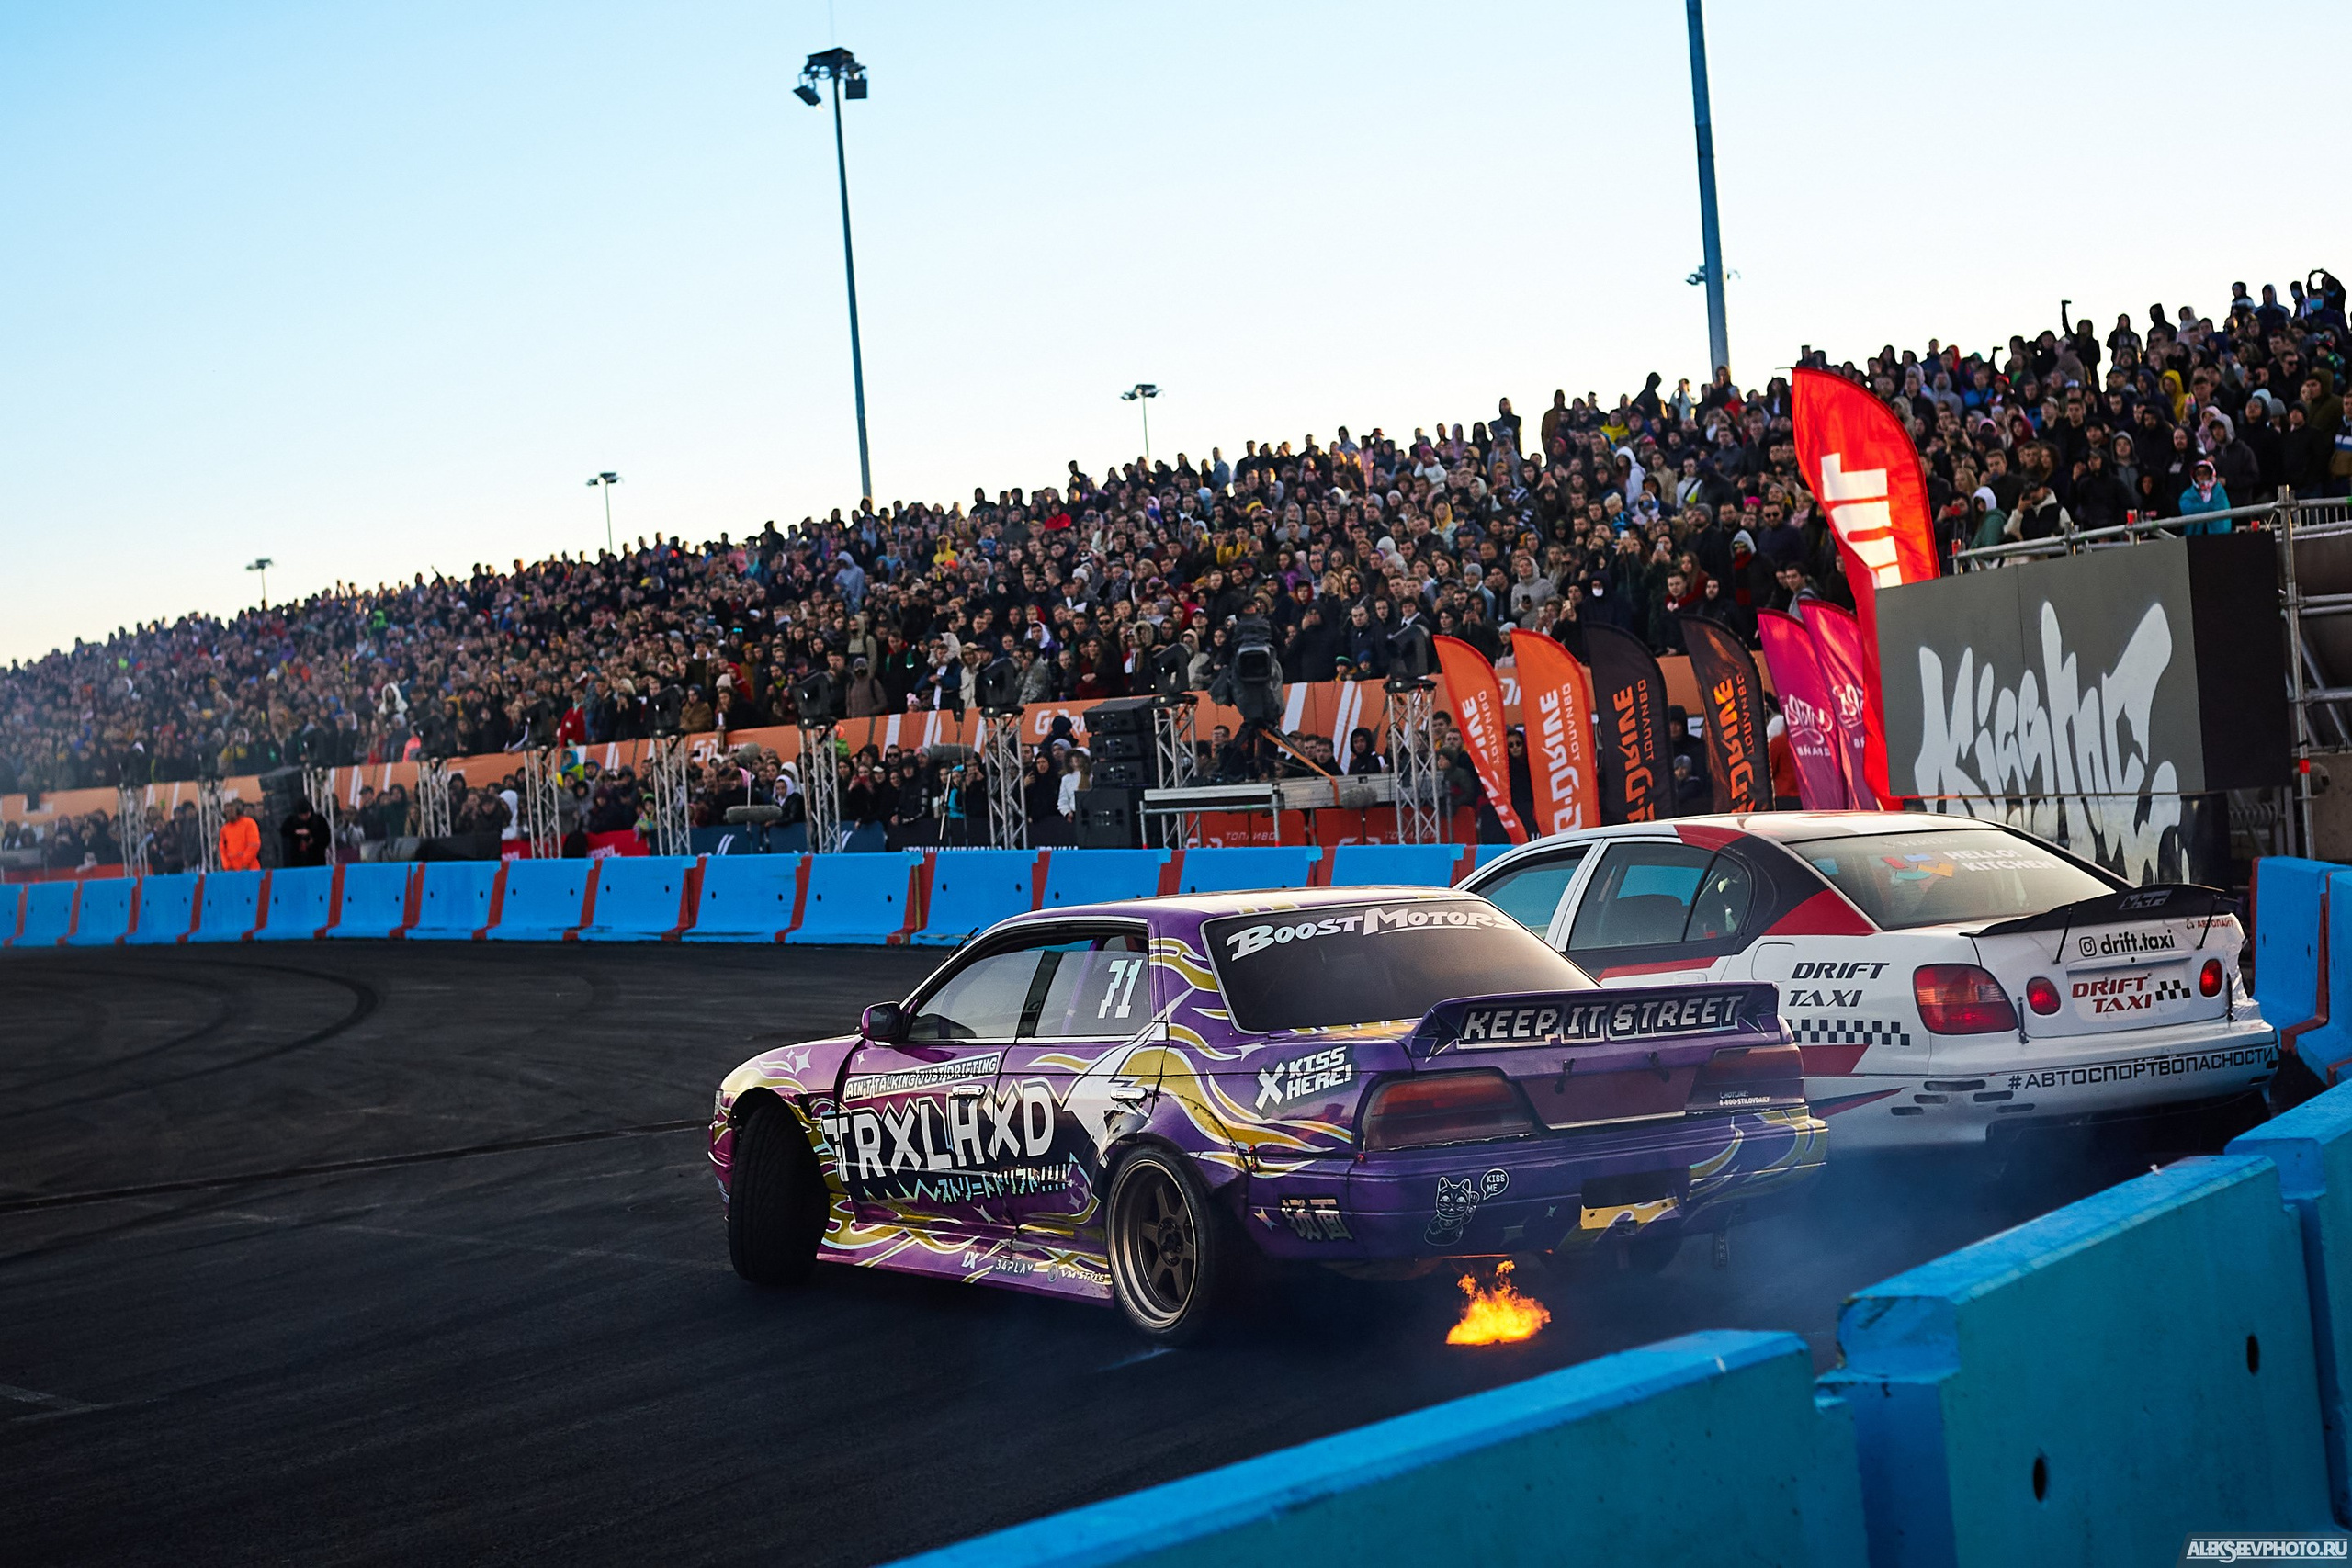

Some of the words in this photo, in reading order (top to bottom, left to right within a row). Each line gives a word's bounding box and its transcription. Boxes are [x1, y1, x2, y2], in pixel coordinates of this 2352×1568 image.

[1226, 831, 1275, 840] ТОПИВО
[1943, 849, 2023, 860] HELLO!
[1962, 860, 2058, 872] KITCHEN
[2100, 929, 2176, 954] drift.taxi
[1791, 962, 1890, 979] DRIFT
[1098, 959, 1143, 1019] 71
[2072, 976, 2148, 998] DRIFT
[1788, 990, 1863, 1007] TAXI
[2092, 993, 2152, 1013] TAXI
[1464, 1008, 1558, 1040] KEEP
[1567, 1006, 1607, 1034] IT
[1613, 995, 1744, 1031] STREET
[1288, 1046, 1347, 1079] KISS
[1287, 1064, 1352, 1100] HERE!
[1487, 1174, 1505, 1183] KISS
[1487, 1184, 1498, 1192] ME
